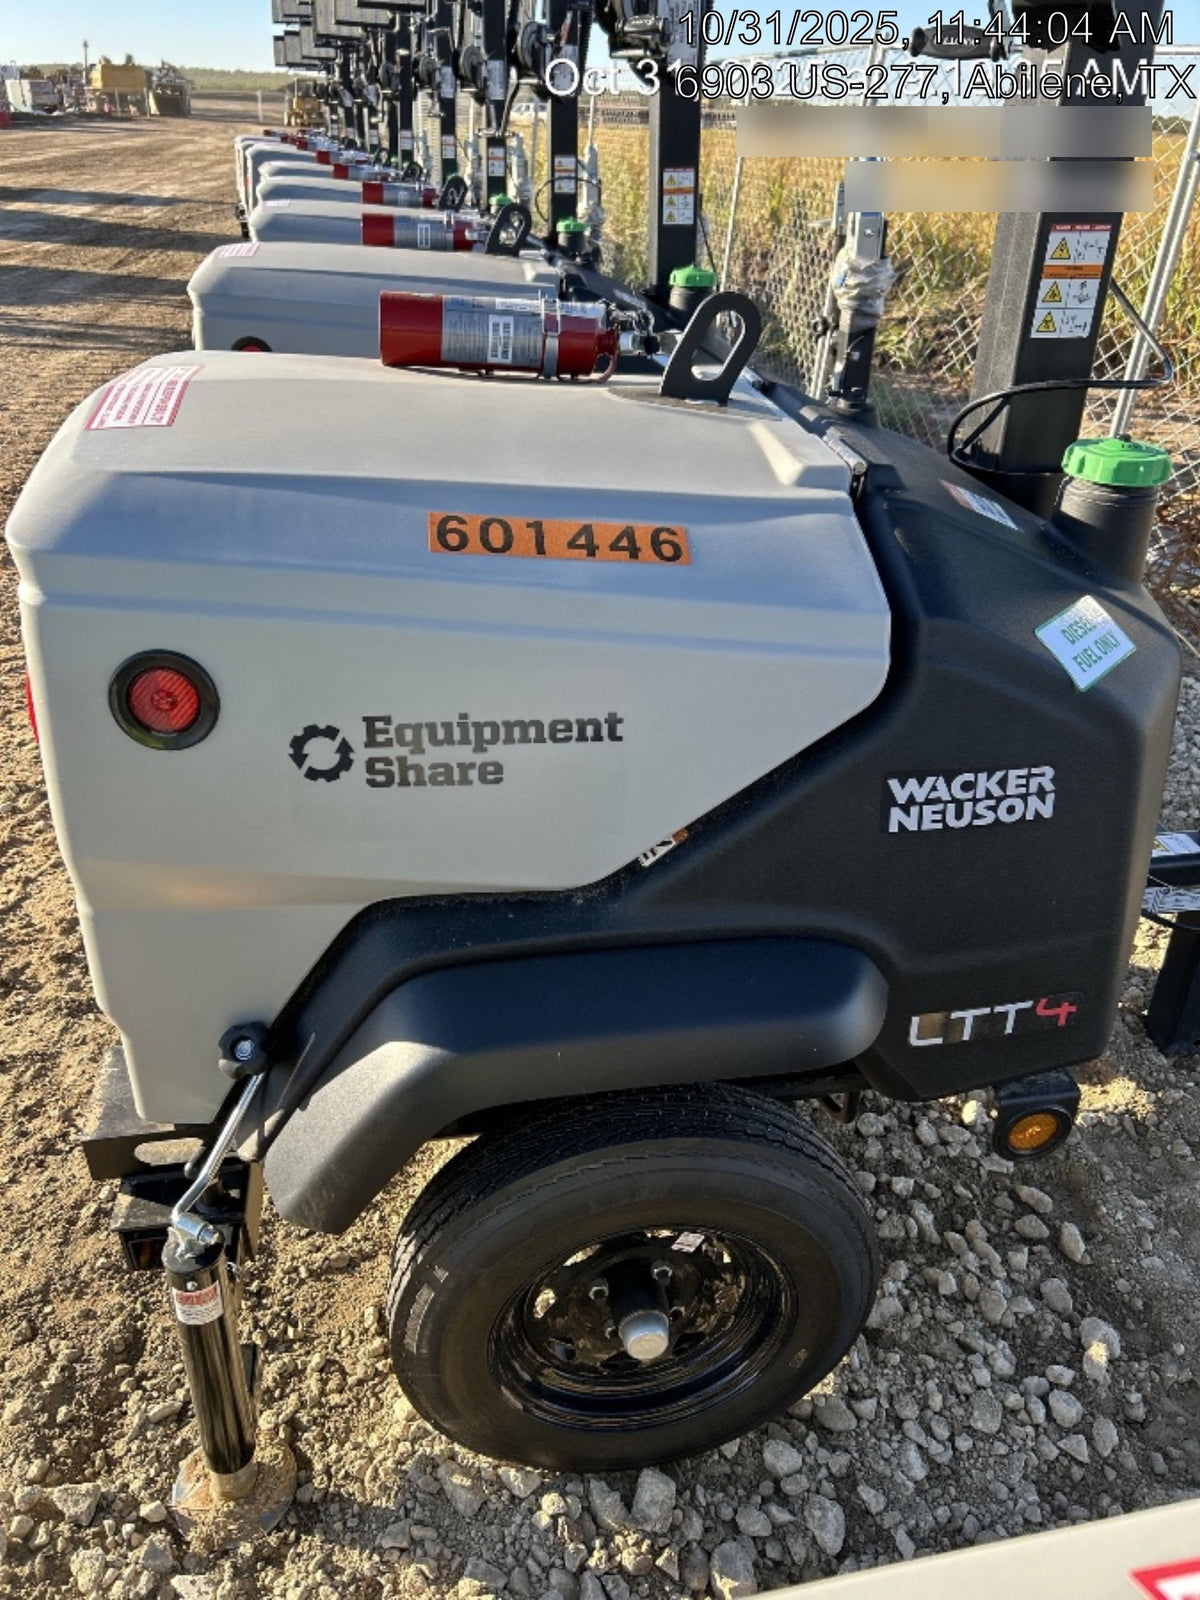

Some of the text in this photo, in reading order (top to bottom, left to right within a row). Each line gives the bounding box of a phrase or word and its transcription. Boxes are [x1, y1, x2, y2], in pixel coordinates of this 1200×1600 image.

[436, 513, 685, 563] 601446
[1073, 630, 1120, 672] FUEL ONLY
[363, 711, 624, 754] Equipment
[365, 756, 504, 788] Share
[887, 765, 1056, 804] WACKER
[888, 792, 1056, 833] NEUSON
[908, 996, 1077, 1048] LTT4
